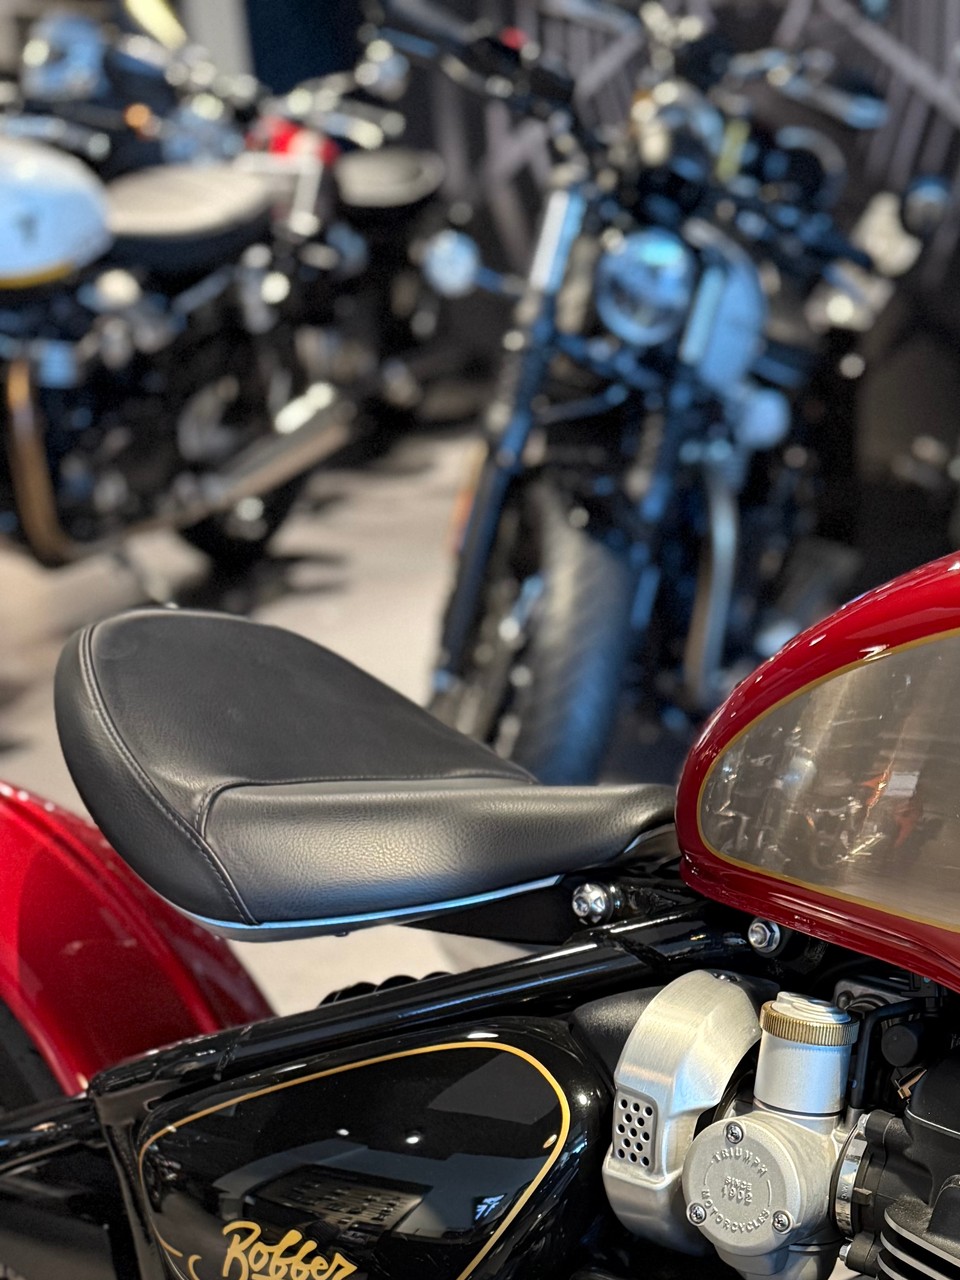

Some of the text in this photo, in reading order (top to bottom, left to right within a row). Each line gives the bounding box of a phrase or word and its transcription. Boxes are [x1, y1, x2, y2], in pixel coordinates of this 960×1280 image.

[713, 1146, 768, 1177] TRIUMPH
[721, 1184, 752, 1206] 1902
[724, 1175, 752, 1193] SINCE
[701, 1188, 770, 1233] MOTORCYCLES
